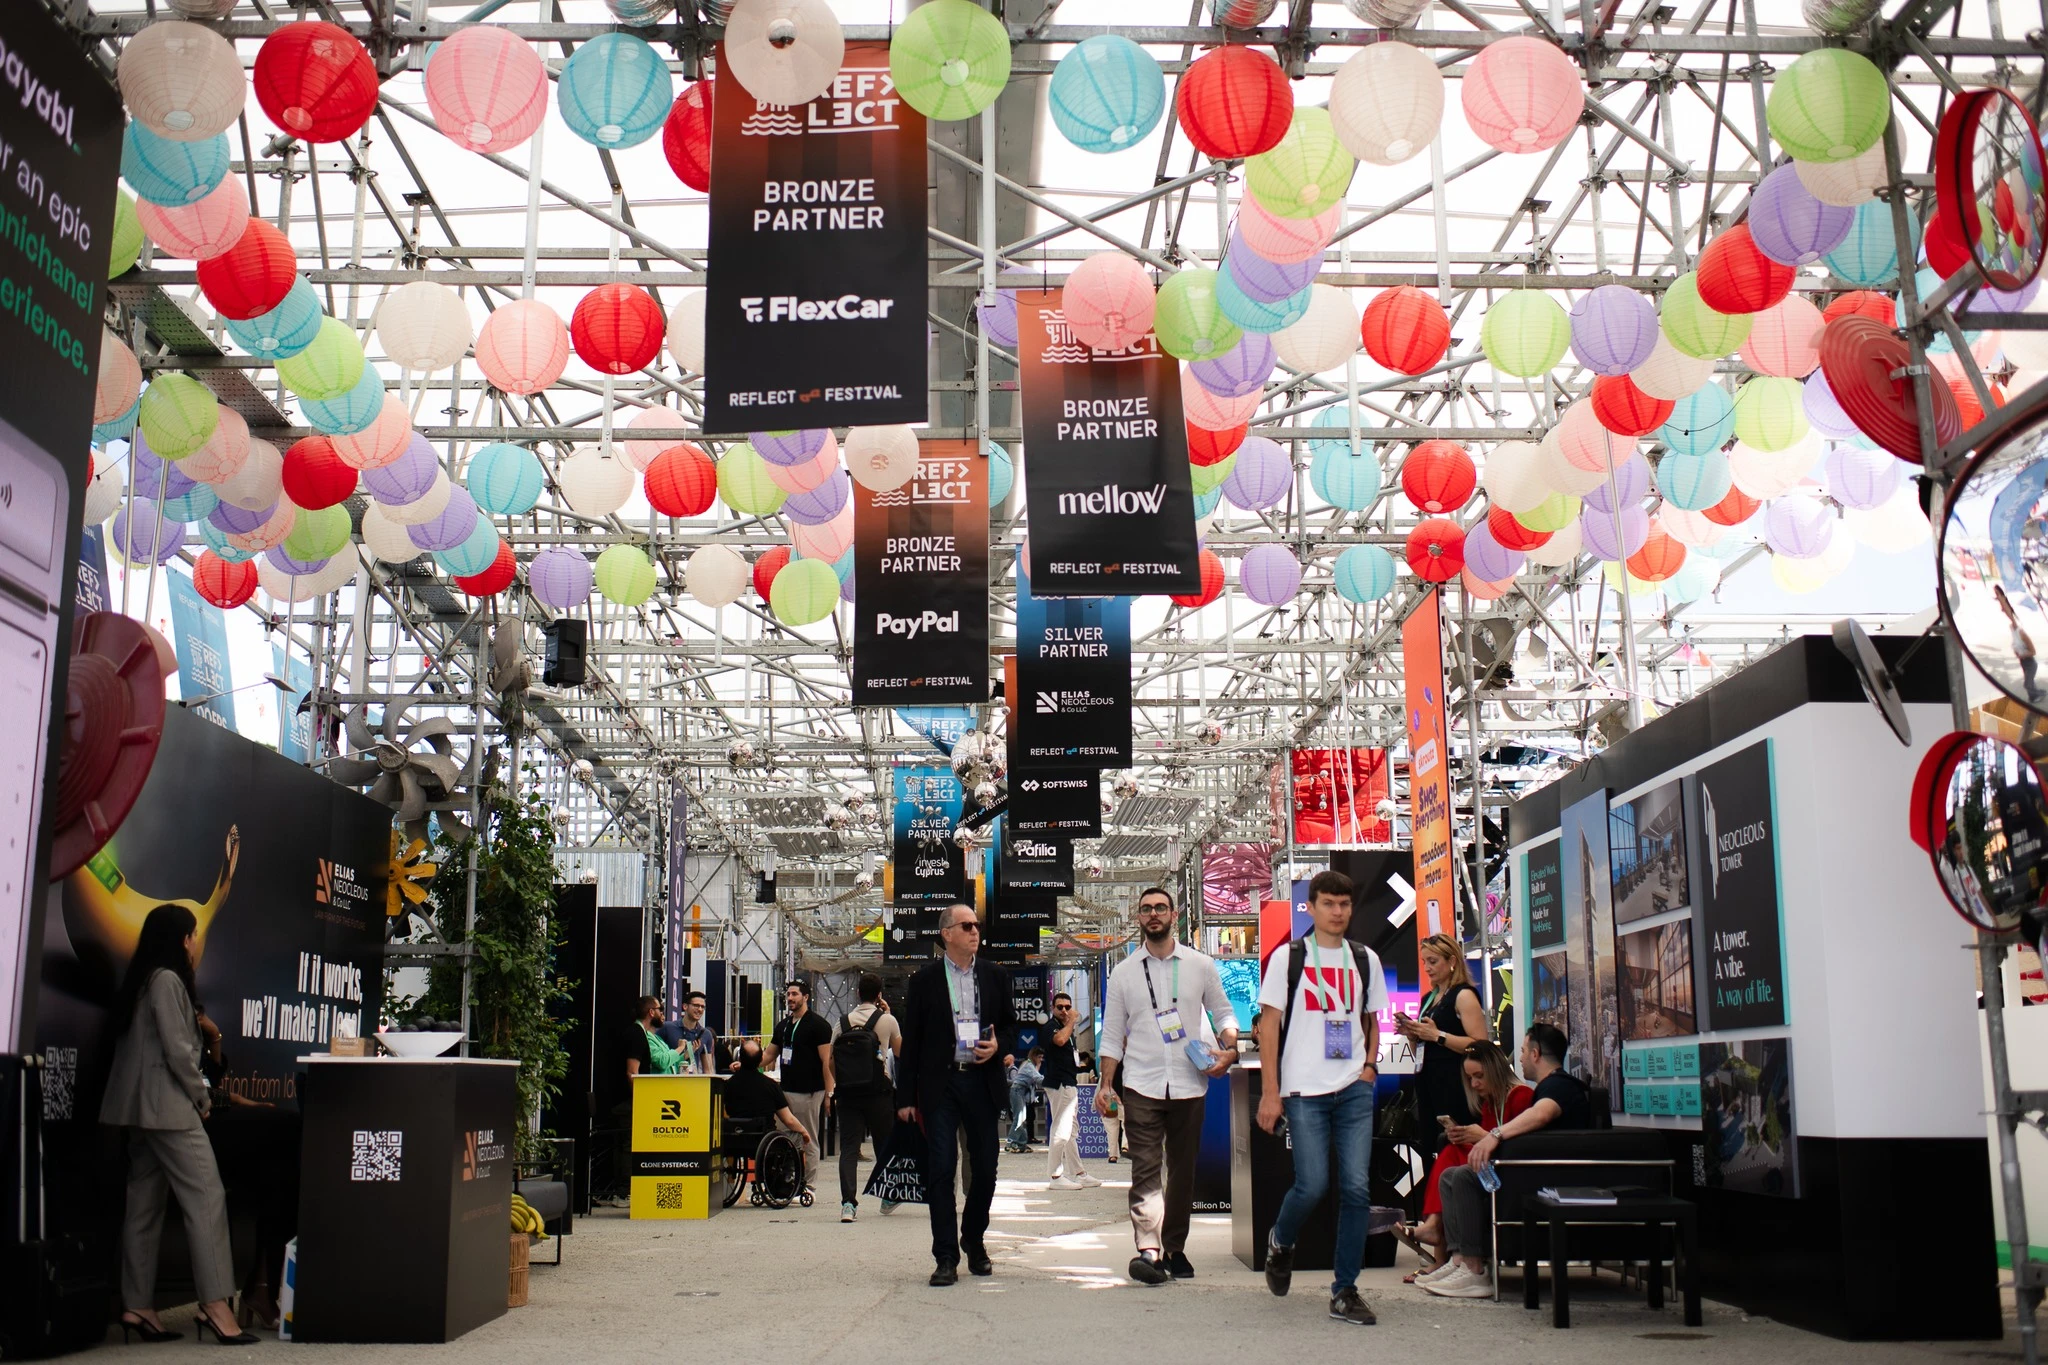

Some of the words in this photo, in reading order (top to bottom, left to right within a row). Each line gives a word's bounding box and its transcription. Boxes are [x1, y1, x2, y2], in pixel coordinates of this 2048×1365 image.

[764, 179, 875, 203] BRONZE
[17, 160, 43, 206] an
[50, 193, 90, 250] epic
[753, 206, 884, 232] PARTNER
[769, 295, 893, 322] FlexCar
[729, 390, 796, 407] REFLECT
[825, 385, 902, 401] FESTIVAL
[1063, 397, 1149, 418] BRONZE
[1057, 419, 1158, 441] PARTNER
[1058, 483, 1167, 515] mellow
[886, 536, 956, 554] BRONZE
[880, 556, 961, 574] PARTNER
[1050, 562, 1102, 574] REFLECT
[1123, 562, 1181, 574] FESTIVAL
[876, 610, 959, 640] PayPal
[1044, 628, 1103, 641] SILVER
[1040, 644, 1108, 658] PARTNER
[867, 678, 908, 688] REFLECT
[925, 676, 973, 686] FESTIVAL
[1061, 690, 1090, 698] ELIAS
[1061, 698, 1114, 706] NEOCLEOUS
[1030, 748, 1065, 756] REFLECT
[1079, 747, 1119, 755] FESTIVAL
[1042, 780, 1088, 788] SOFTSWISS
[1415, 800, 1445, 832] Everything
[908, 829, 950, 839] PARTNER
[1719, 820, 1765, 853] NEOCLEOUS
[1018, 844, 1056, 857] Pafilia
[915, 866, 945, 878] Cyprus
[919, 858, 945, 867] invest
[1720, 852, 1743, 872] TOWER
[334, 864, 354, 881] ELIAS
[333, 879, 368, 901] NEOCLEOUS
[1713, 931, 1722, 953] A
[1722, 930, 1750, 952] tower.
[298, 951, 310, 993] If
[311, 955, 321, 996] it
[324, 962, 363, 1004] works,
[1715, 959, 1723, 981] A
[1725, 954, 1745, 978] vibe.
[1717, 986, 1724, 1008] A
[1725, 988, 1743, 1011] way
[1745, 980, 1755, 1004] of
[1757, 978, 1774, 1003] life.
[279, 1000, 316, 1044] make
[318, 1004, 329, 1044] it
[252, 1070, 280, 1098] from
[478, 1129, 494, 1145] ELIAS
[477, 1145, 505, 1162] NEOCLEOUS
[868, 1182, 886, 1198] All
